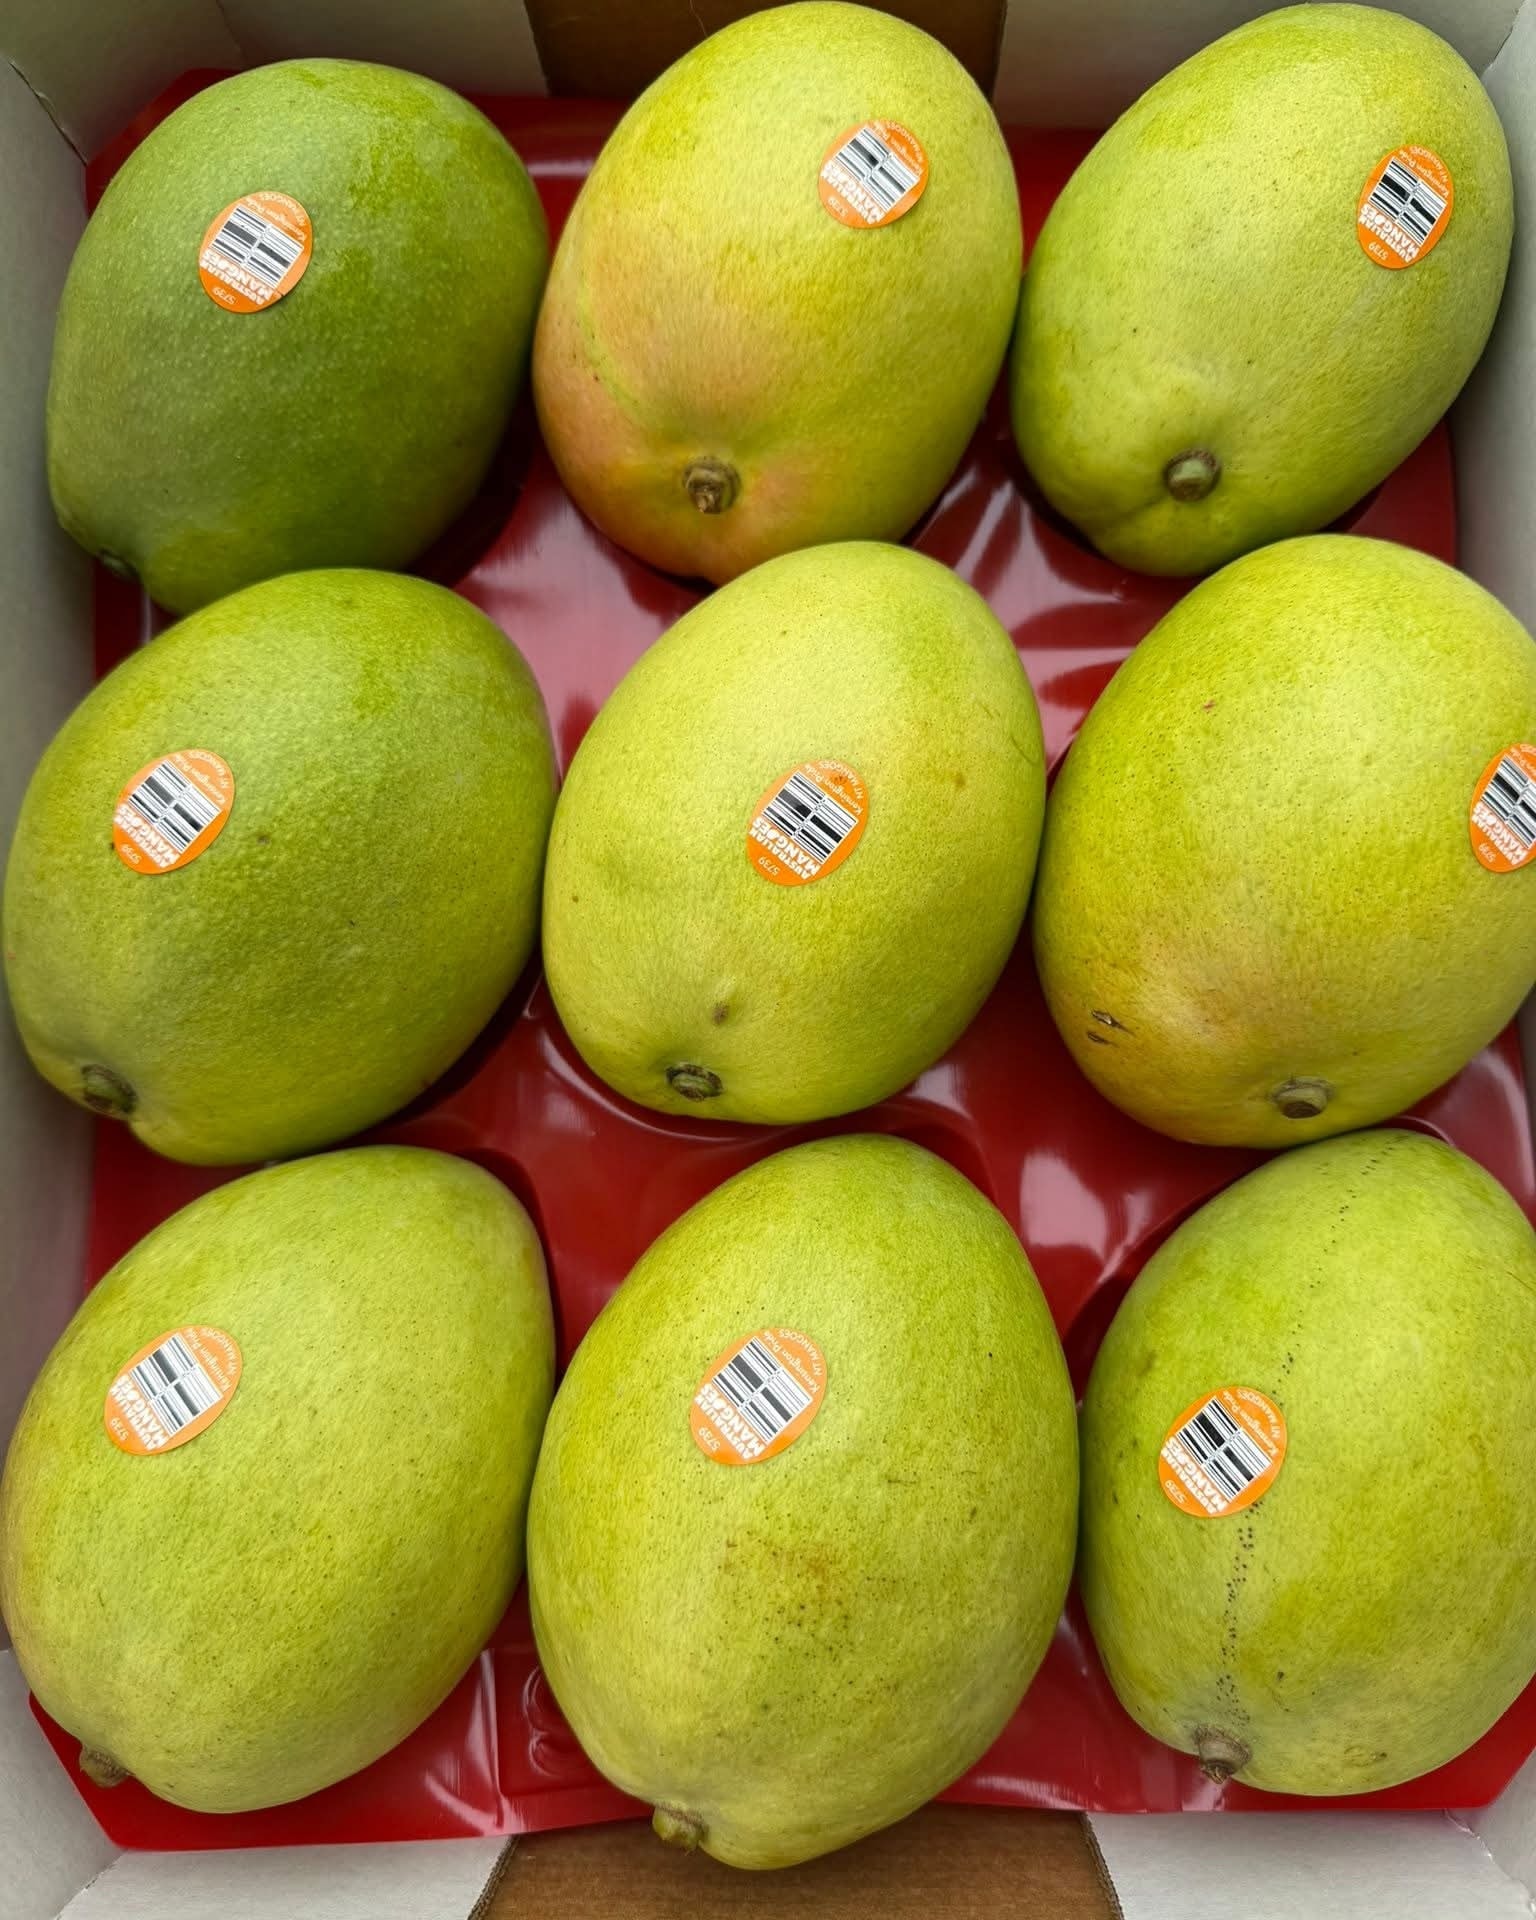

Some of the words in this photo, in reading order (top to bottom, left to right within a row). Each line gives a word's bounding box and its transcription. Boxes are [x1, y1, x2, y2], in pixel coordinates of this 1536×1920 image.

[1358, 216, 1412, 262] AUSTRALIAN
[1361, 203, 1420, 258] MANGOES
[202, 249, 274, 301] MANGOES
[804, 764, 824, 783] Pride
[818, 760, 859, 787] MANGOES
[824, 778, 863, 814] Kensington
[749, 828, 810, 879] AUSTRALIAN
[753, 816, 820, 875] MANGOES
[758, 856, 780, 876] 5739
[763, 1331, 782, 1352] Pride
[694, 1394, 753, 1460] AUSTRALIAN
[700, 1384, 766, 1456] MANGOES
[1166, 1436, 1228, 1512] MANGOES
